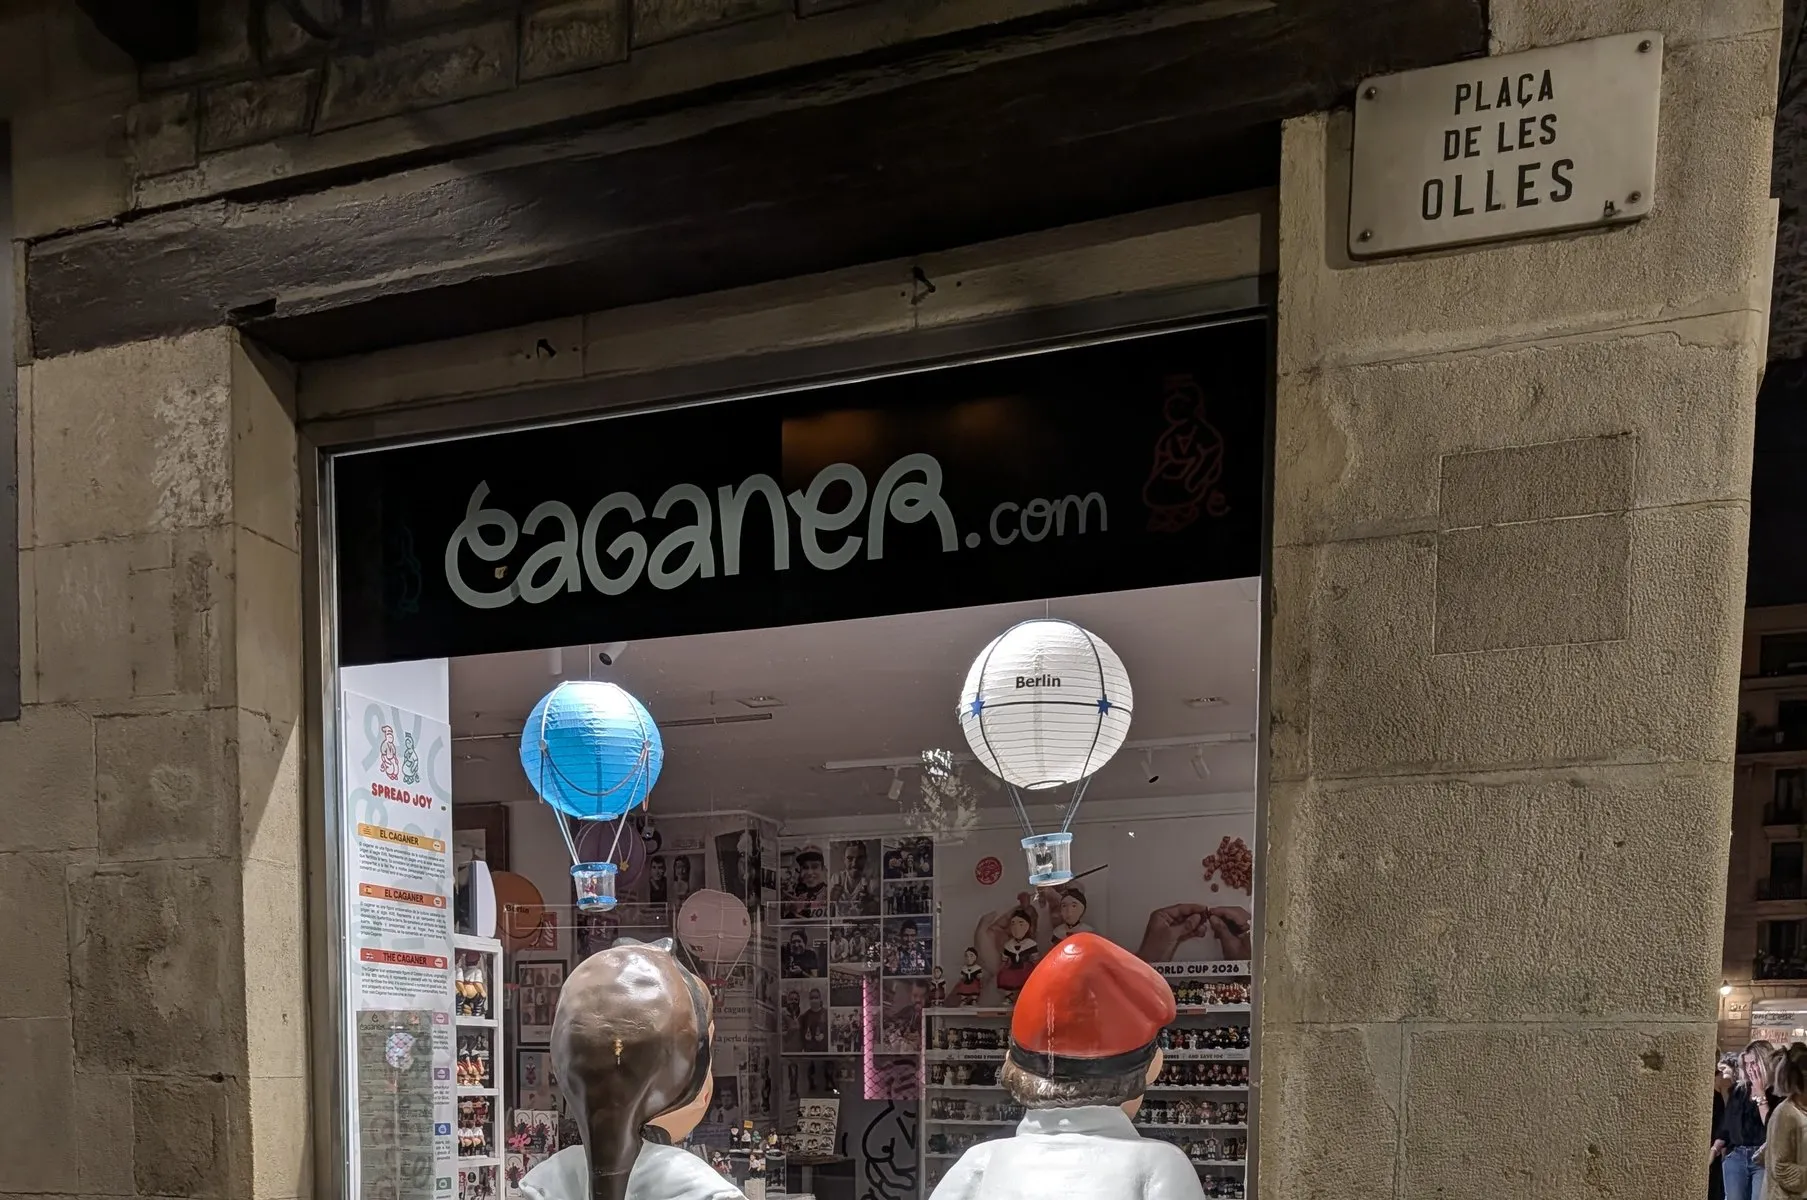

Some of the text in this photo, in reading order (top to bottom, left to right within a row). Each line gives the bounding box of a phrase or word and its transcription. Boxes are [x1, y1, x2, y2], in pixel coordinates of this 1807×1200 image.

[1454, 69, 1554, 115] PLAÇA
[1444, 114, 1557, 161] DE LES
[1422, 159, 1574, 220] OLLES
[1015, 674, 1061, 689] Berlin
[371, 782, 433, 809] SPREAD JOY
[380, 830, 420, 845] EL CAGANER
[384, 889, 424, 903] EL CAGANER
[383, 953, 427, 965] THE CAGANER
[1188, 965, 1209, 974] CUP
[1212, 964, 1239, 974] 2026
